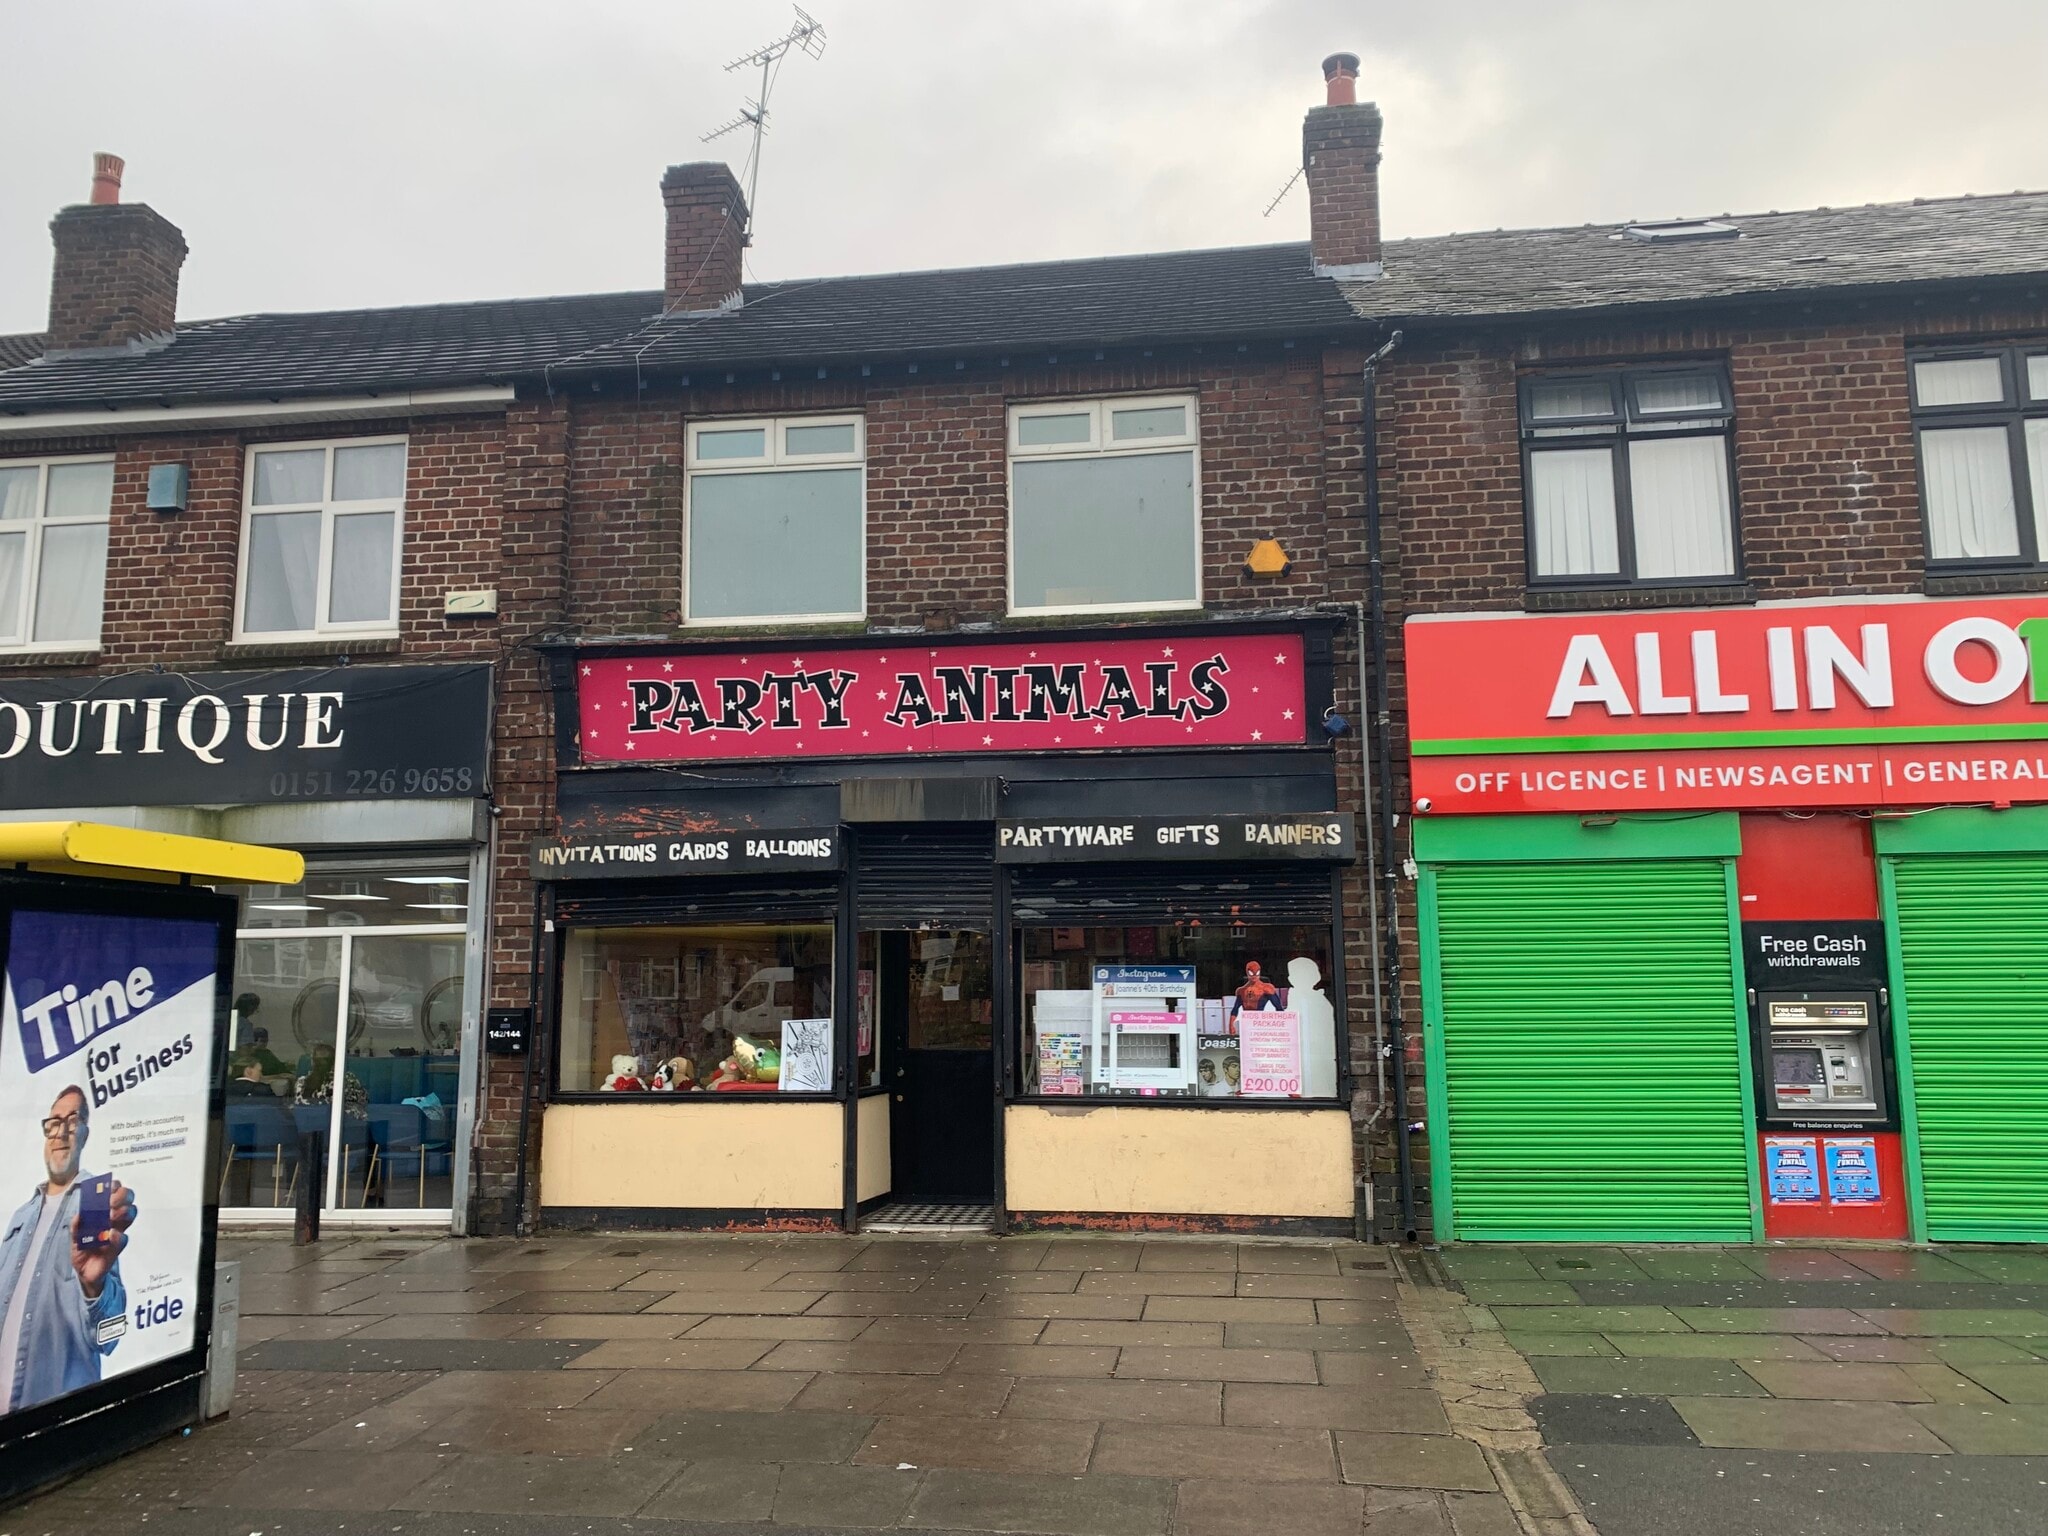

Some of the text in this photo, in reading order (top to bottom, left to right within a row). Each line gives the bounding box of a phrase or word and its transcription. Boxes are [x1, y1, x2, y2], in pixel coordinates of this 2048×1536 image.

[1546, 630, 1750, 719] ALL
[1766, 624, 1895, 710] IN
[628, 653, 1230, 735] PARTY ANIMALS
[0, 692, 345, 764] OUTIQUE
[270, 767, 472, 796] 0151 226 9658
[1456, 759, 2048, 792] OFF LICENCE NEWSAGENT GENERAL
[1000, 823, 1342, 848] PARTYWARE GIFTS BANNERS
[539, 838, 831, 866] INVITATIONS CARDS BALLOONS
[1760, 934, 1867, 953] Free Cash
[1767, 953, 1861, 968] withdrawals
[1117, 969, 1167, 982] Instagram
[1115, 984, 1142, 995] Joanne's
[1160, 984, 1187, 995] Birthday
[22, 966, 155, 1060] Time
[1128, 1014, 1166, 1023] Instagram
[1262, 1012, 1296, 1020] BIRTHDAY
[489, 1030, 521, 1038] 142/144
[1204, 1038, 1237, 1049] oasis
[86, 1043, 120, 1079] for
[89, 1034, 193, 1108] business
[1244, 1078, 1299, 1092] £20.00
[126, 1120, 151, 1129] built-in
[152, 1115, 185, 1124] accounting
[130, 1143, 160, 1153] business
[1779, 1158, 1807, 1166] FUNFAIR
[1837, 1159, 1866, 1167] FUNFAIR
[135, 1295, 183, 1330] tide
